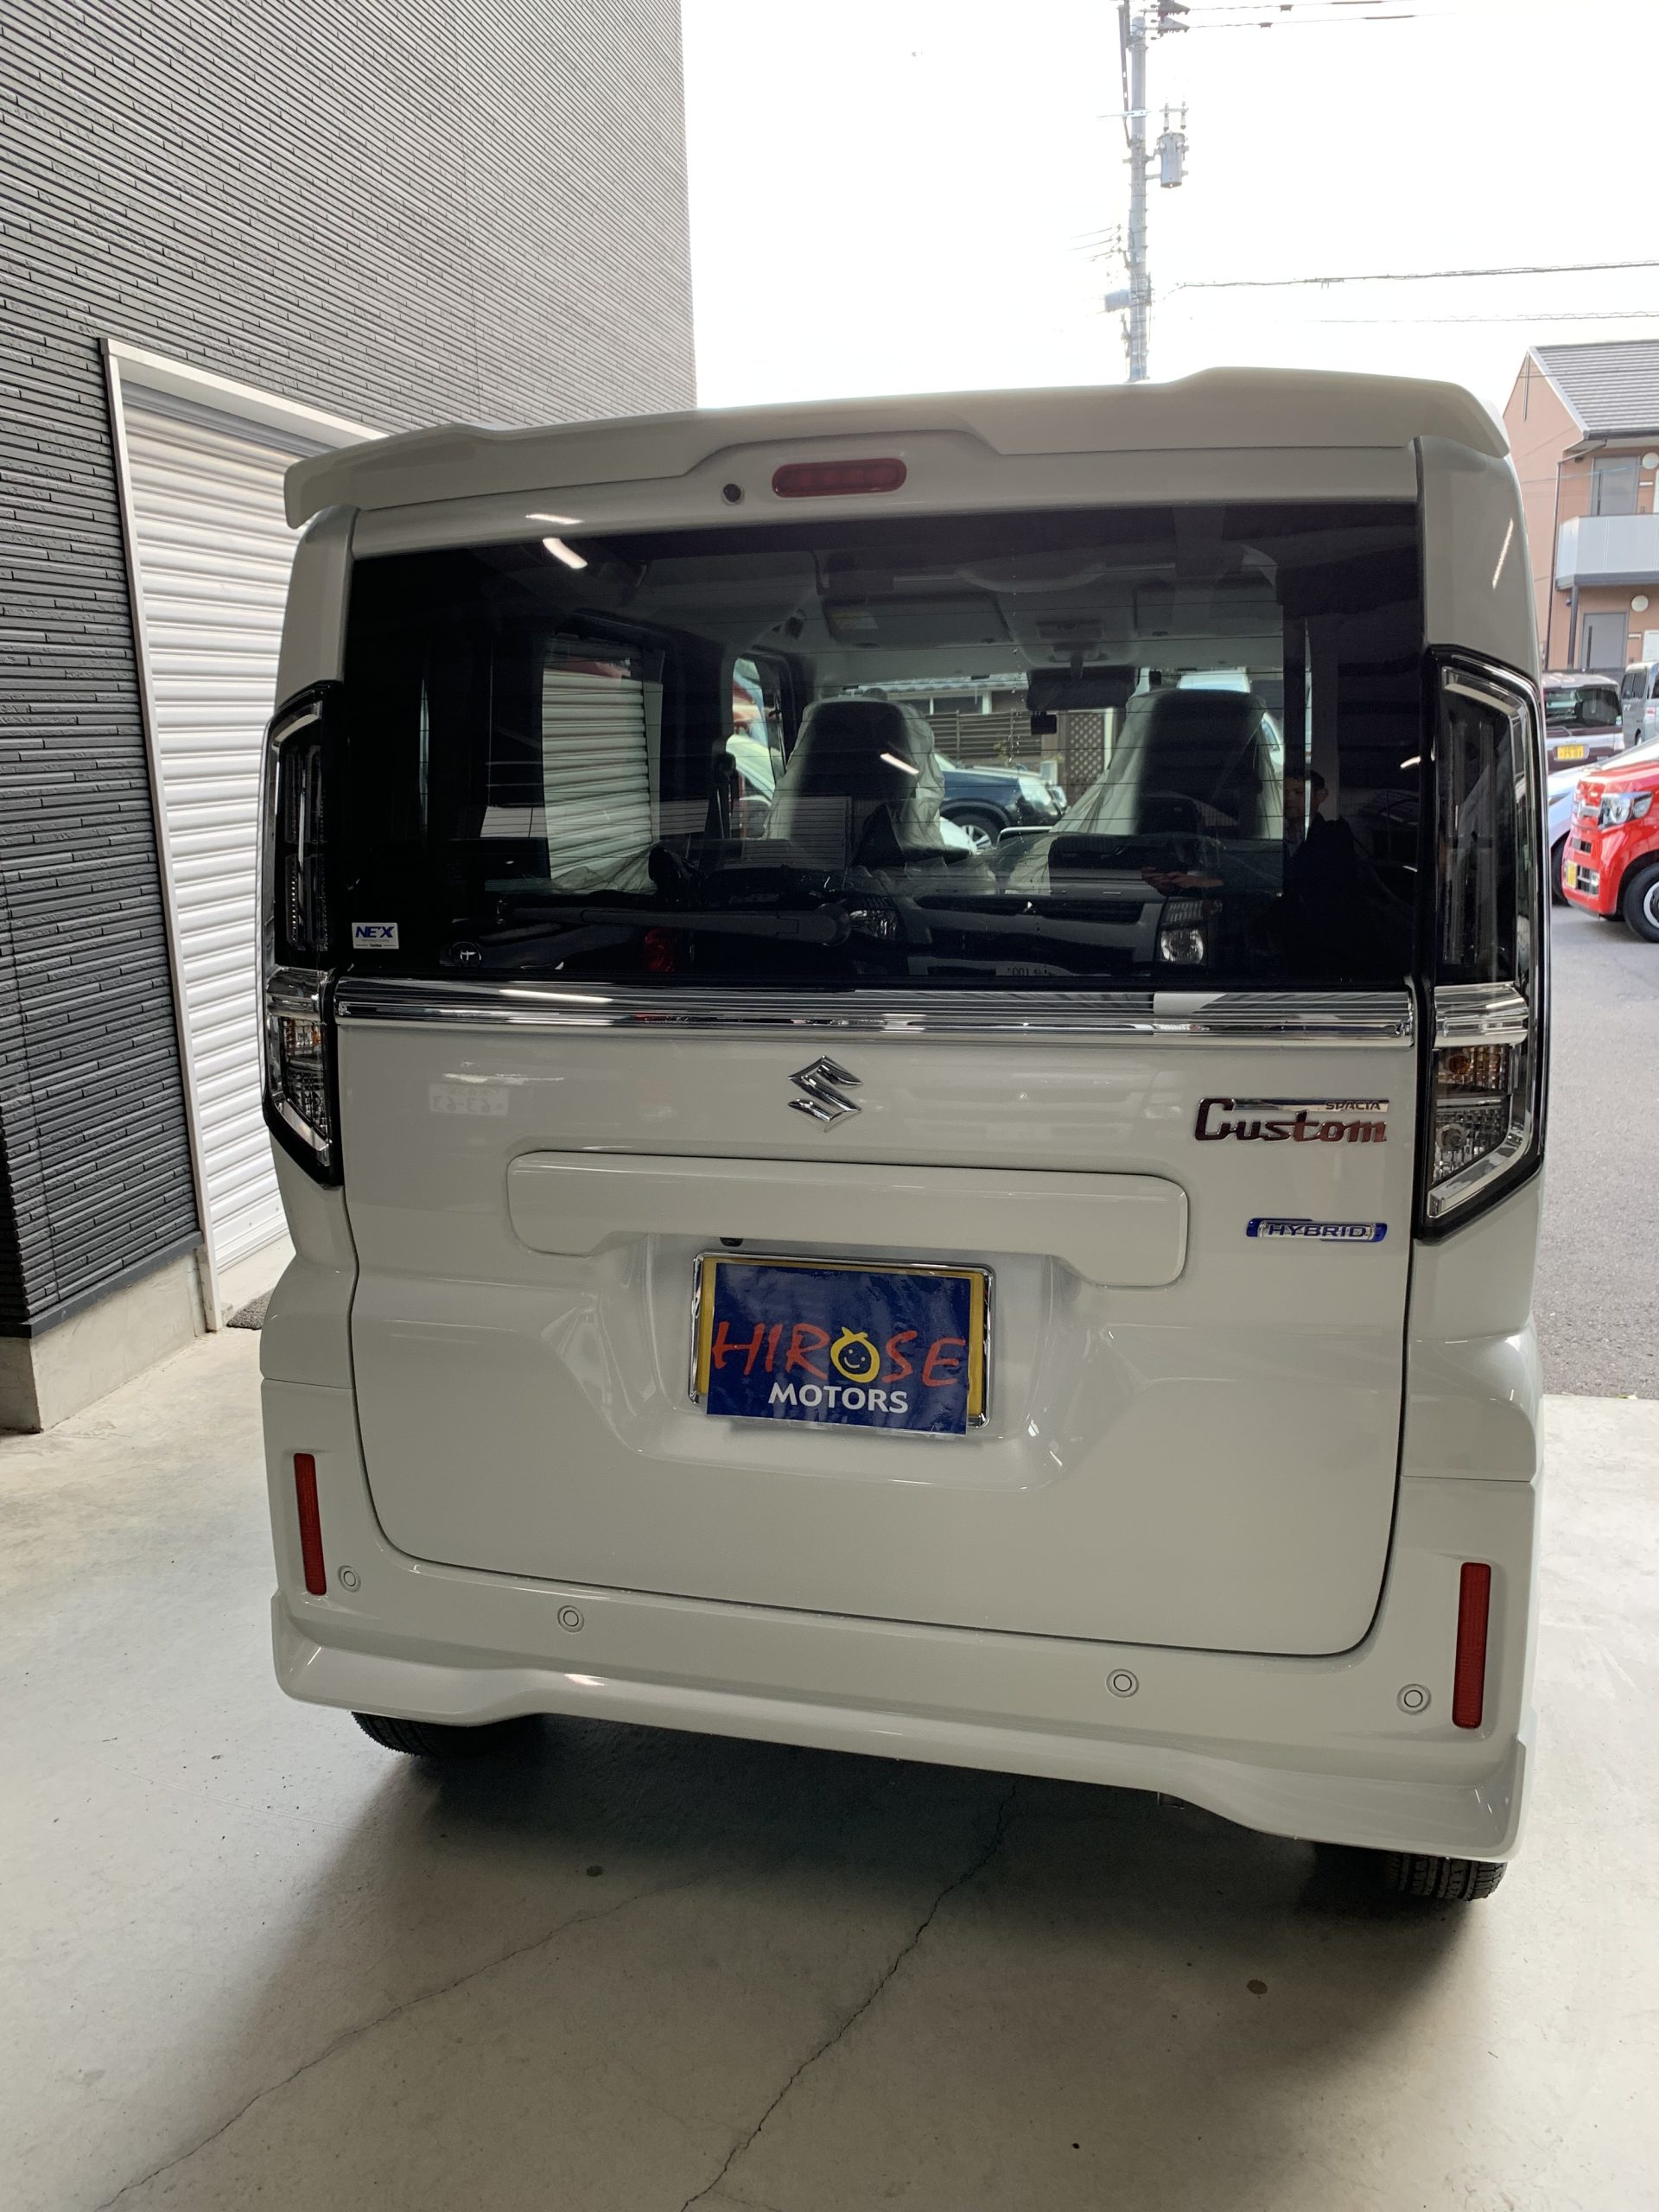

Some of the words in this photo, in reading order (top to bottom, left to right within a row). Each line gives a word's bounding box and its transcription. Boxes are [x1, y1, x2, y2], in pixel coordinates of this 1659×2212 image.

[1195, 1097, 1387, 1142] Custom
[1325, 1101, 1381, 1110] SPACIA
[1268, 1224, 1367, 1238] HYBRID
[712, 1319, 966, 1388] HIROSE
[768, 1382, 909, 1414] MOTORS
